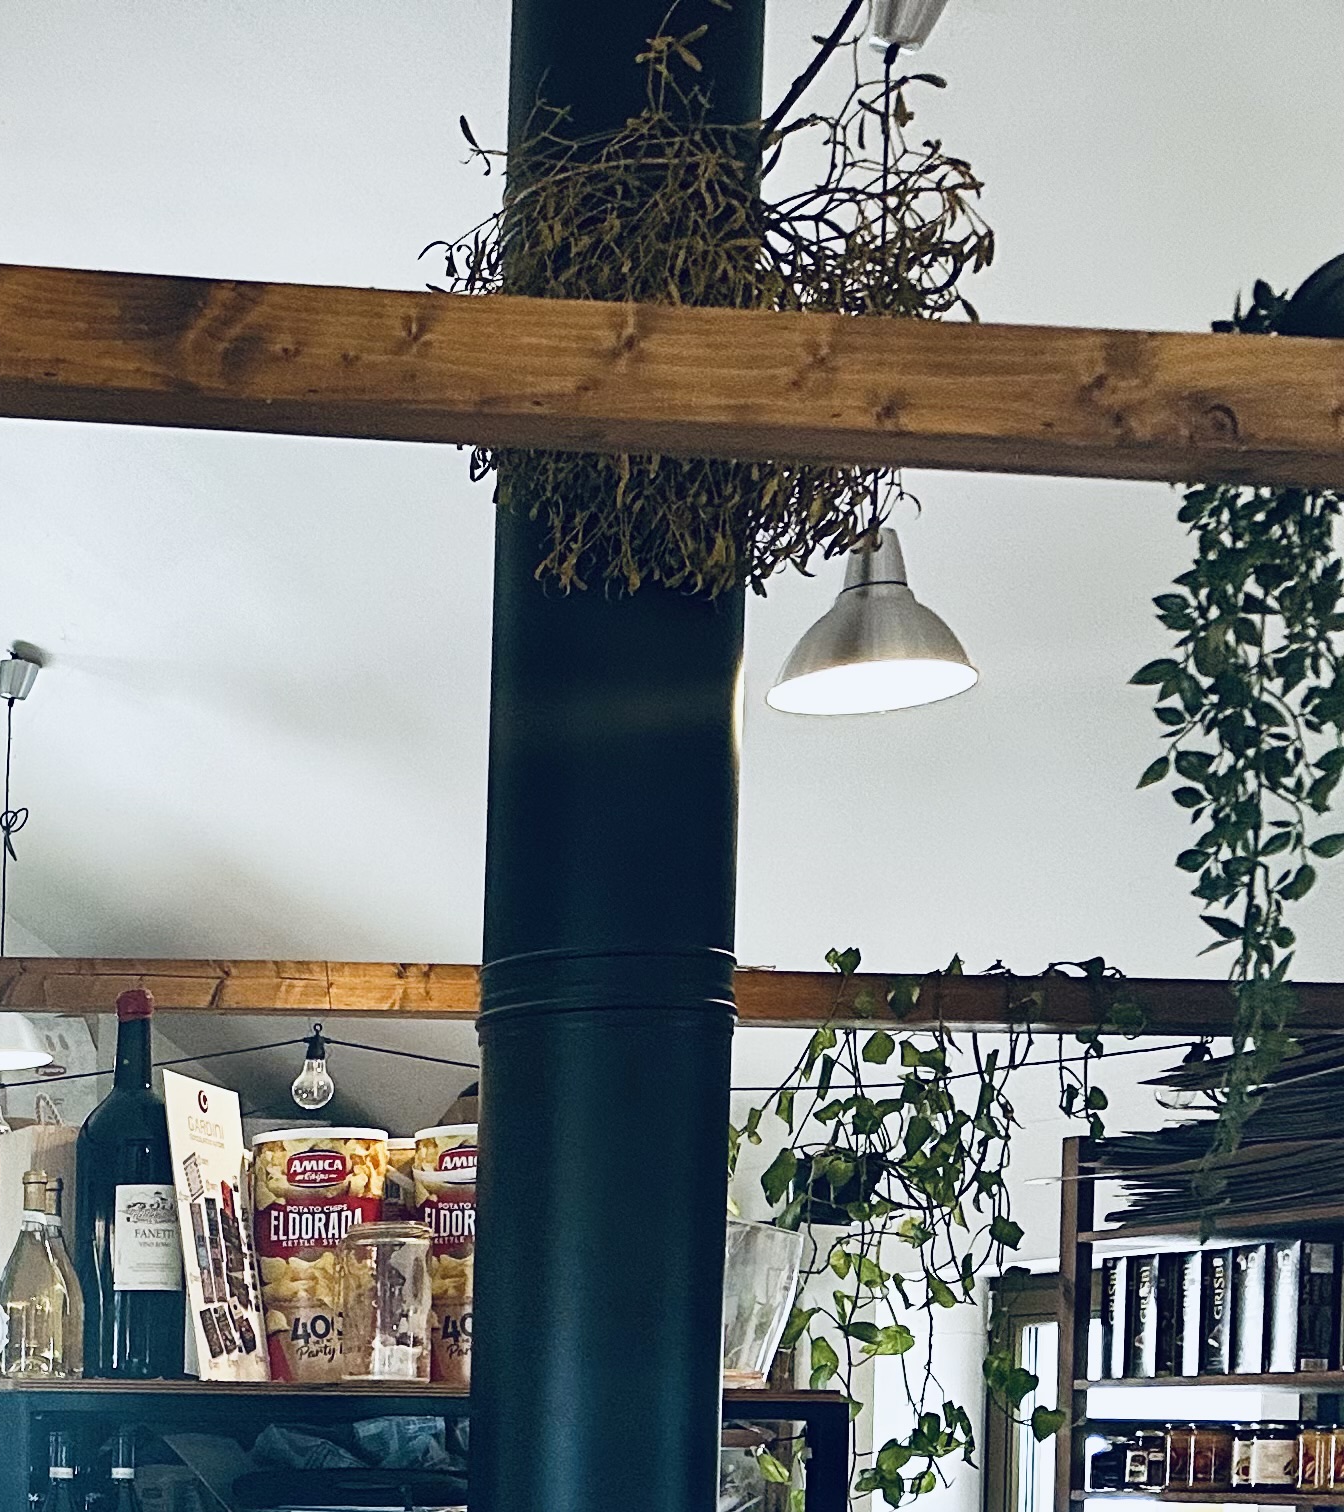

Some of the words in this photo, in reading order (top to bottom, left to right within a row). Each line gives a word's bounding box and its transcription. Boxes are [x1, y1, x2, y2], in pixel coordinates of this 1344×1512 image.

[290, 1159, 343, 1174] AMICA
[287, 1205, 321, 1213] POTATO
[324, 1203, 348, 1212] CHIPS
